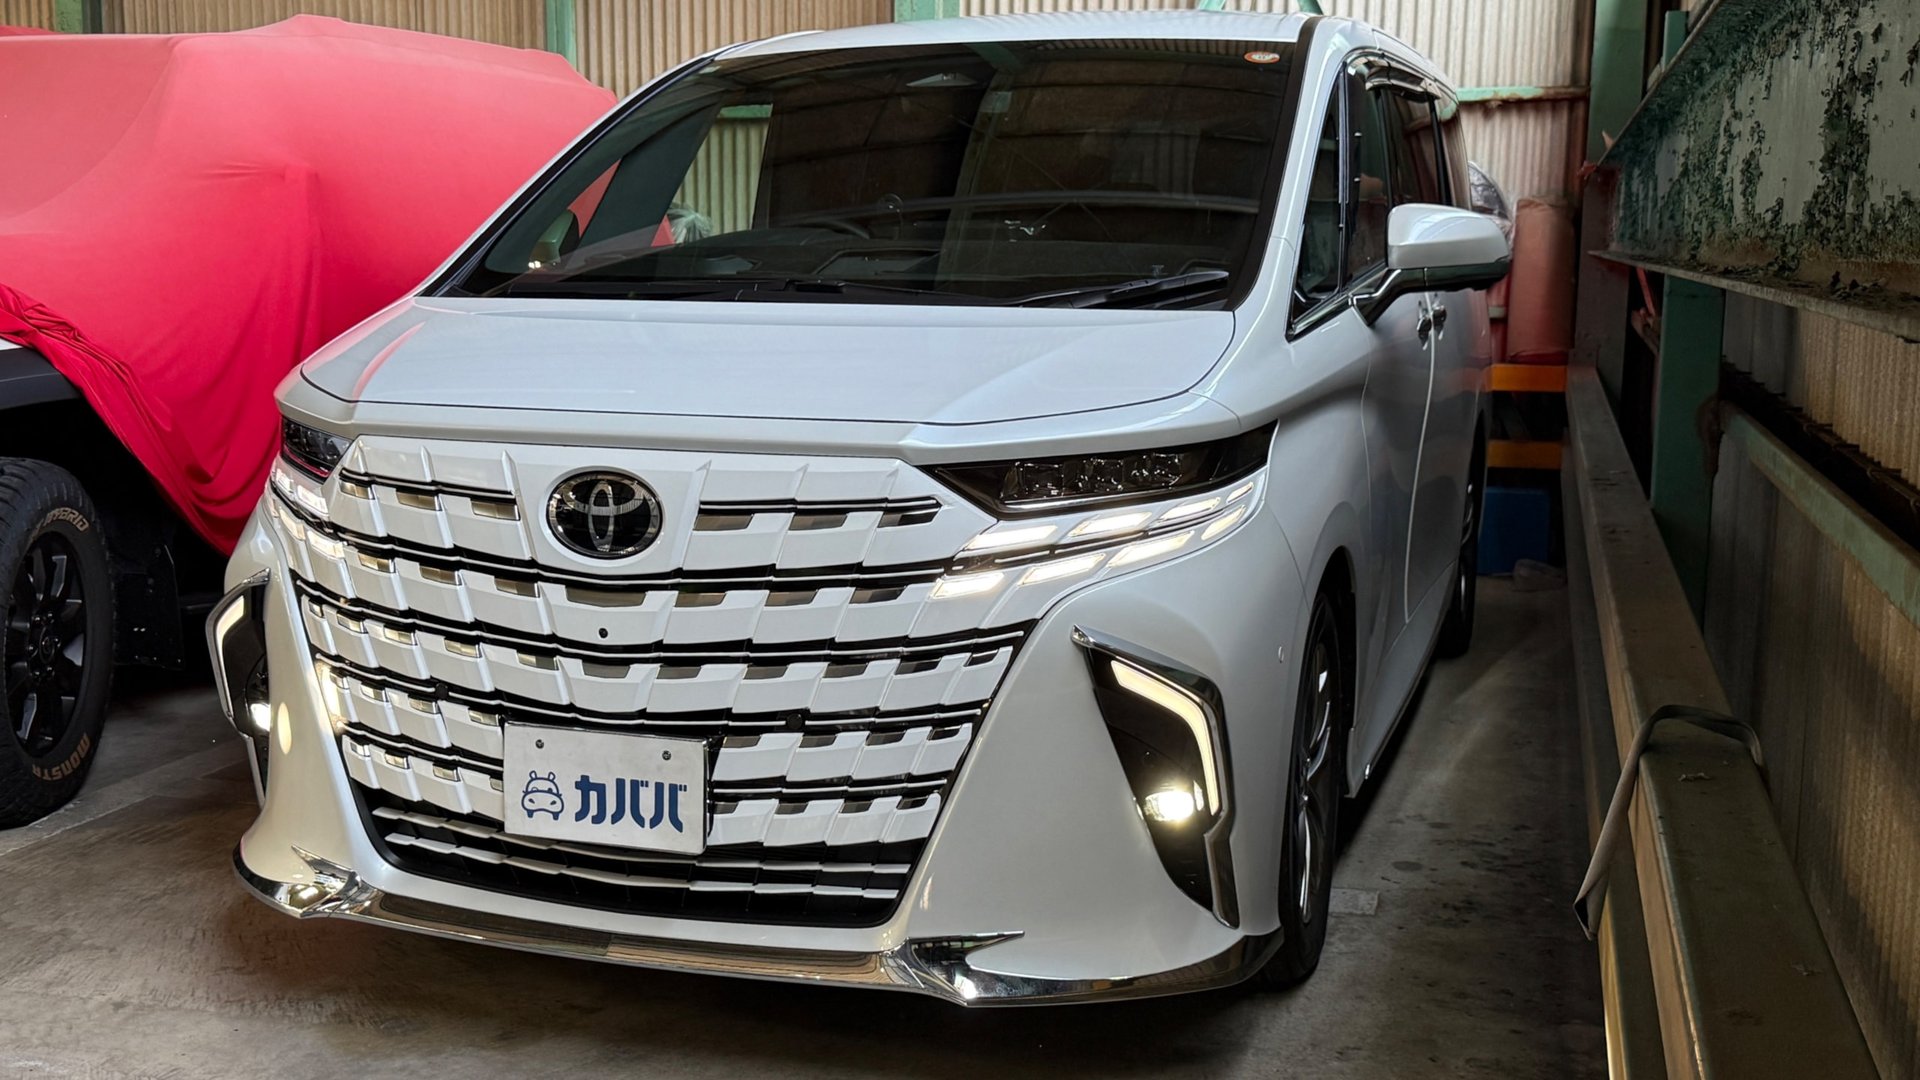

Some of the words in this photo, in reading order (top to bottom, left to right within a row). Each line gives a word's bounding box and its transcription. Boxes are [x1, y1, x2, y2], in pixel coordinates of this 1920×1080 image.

[43, 507, 90, 532] HYBRID
[575, 775, 688, 833] カババ
